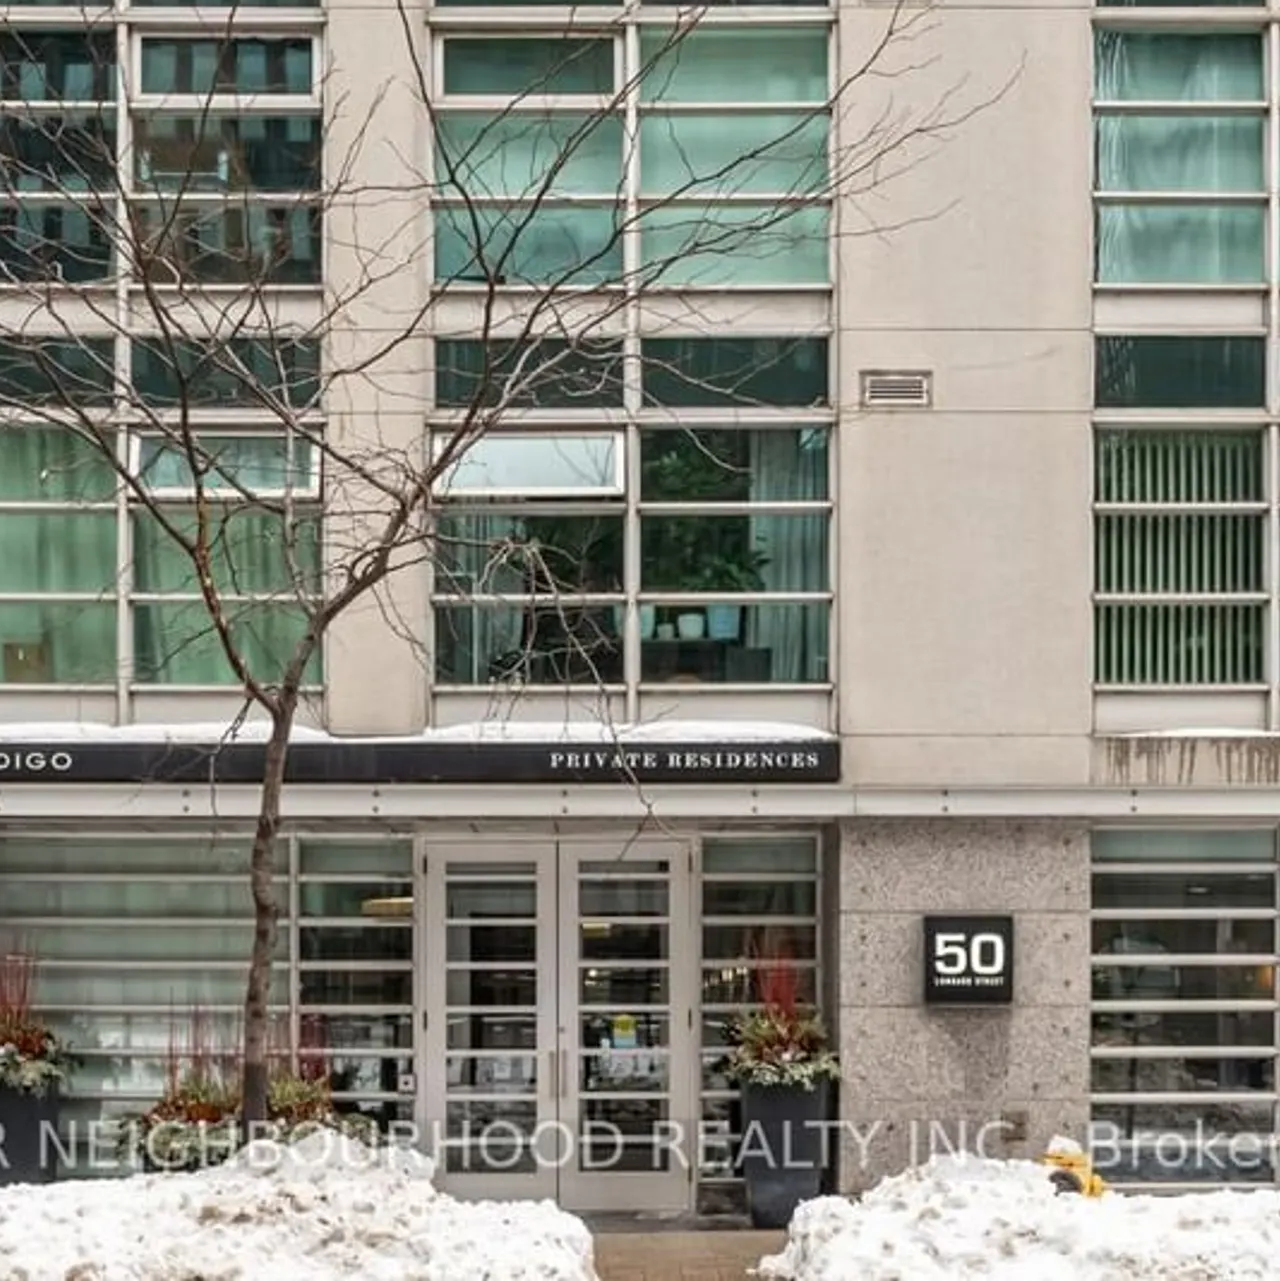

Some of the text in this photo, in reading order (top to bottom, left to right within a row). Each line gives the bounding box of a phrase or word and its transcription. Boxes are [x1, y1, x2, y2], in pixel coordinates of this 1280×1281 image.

[549, 752, 820, 769] PRIVATE RESIDENCES
[935, 932, 1004, 975] 50
